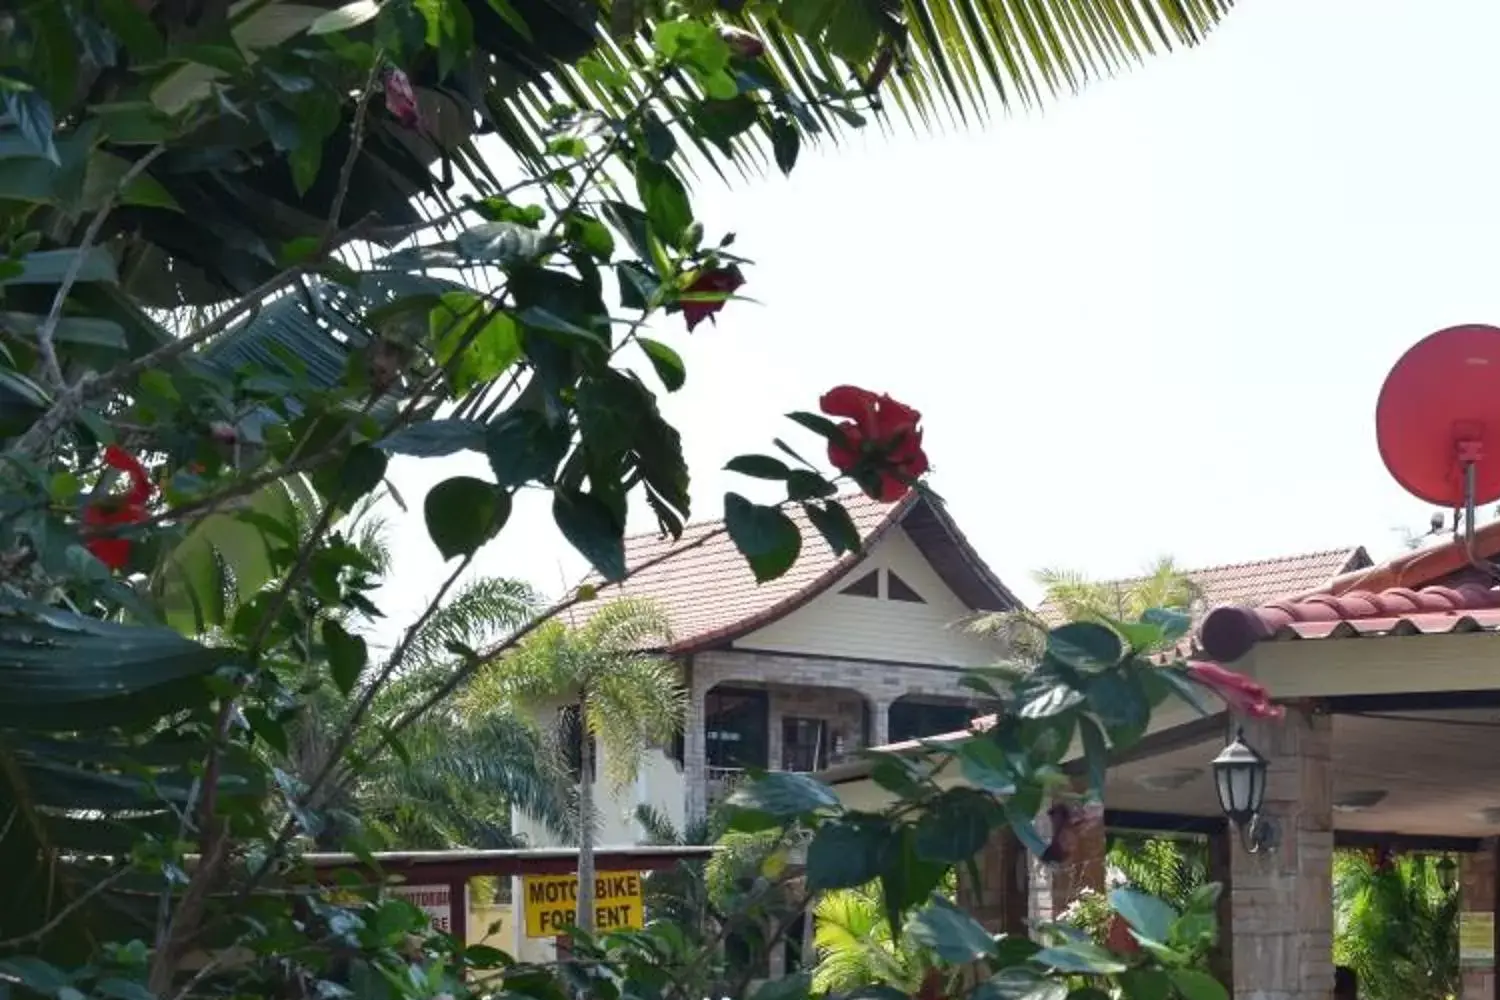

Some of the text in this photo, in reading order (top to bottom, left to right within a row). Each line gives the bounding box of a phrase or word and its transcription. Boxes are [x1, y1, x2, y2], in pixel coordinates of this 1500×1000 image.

[529, 875, 639, 905] MOTOBIKE
[539, 904, 632, 933] FOR ENT
